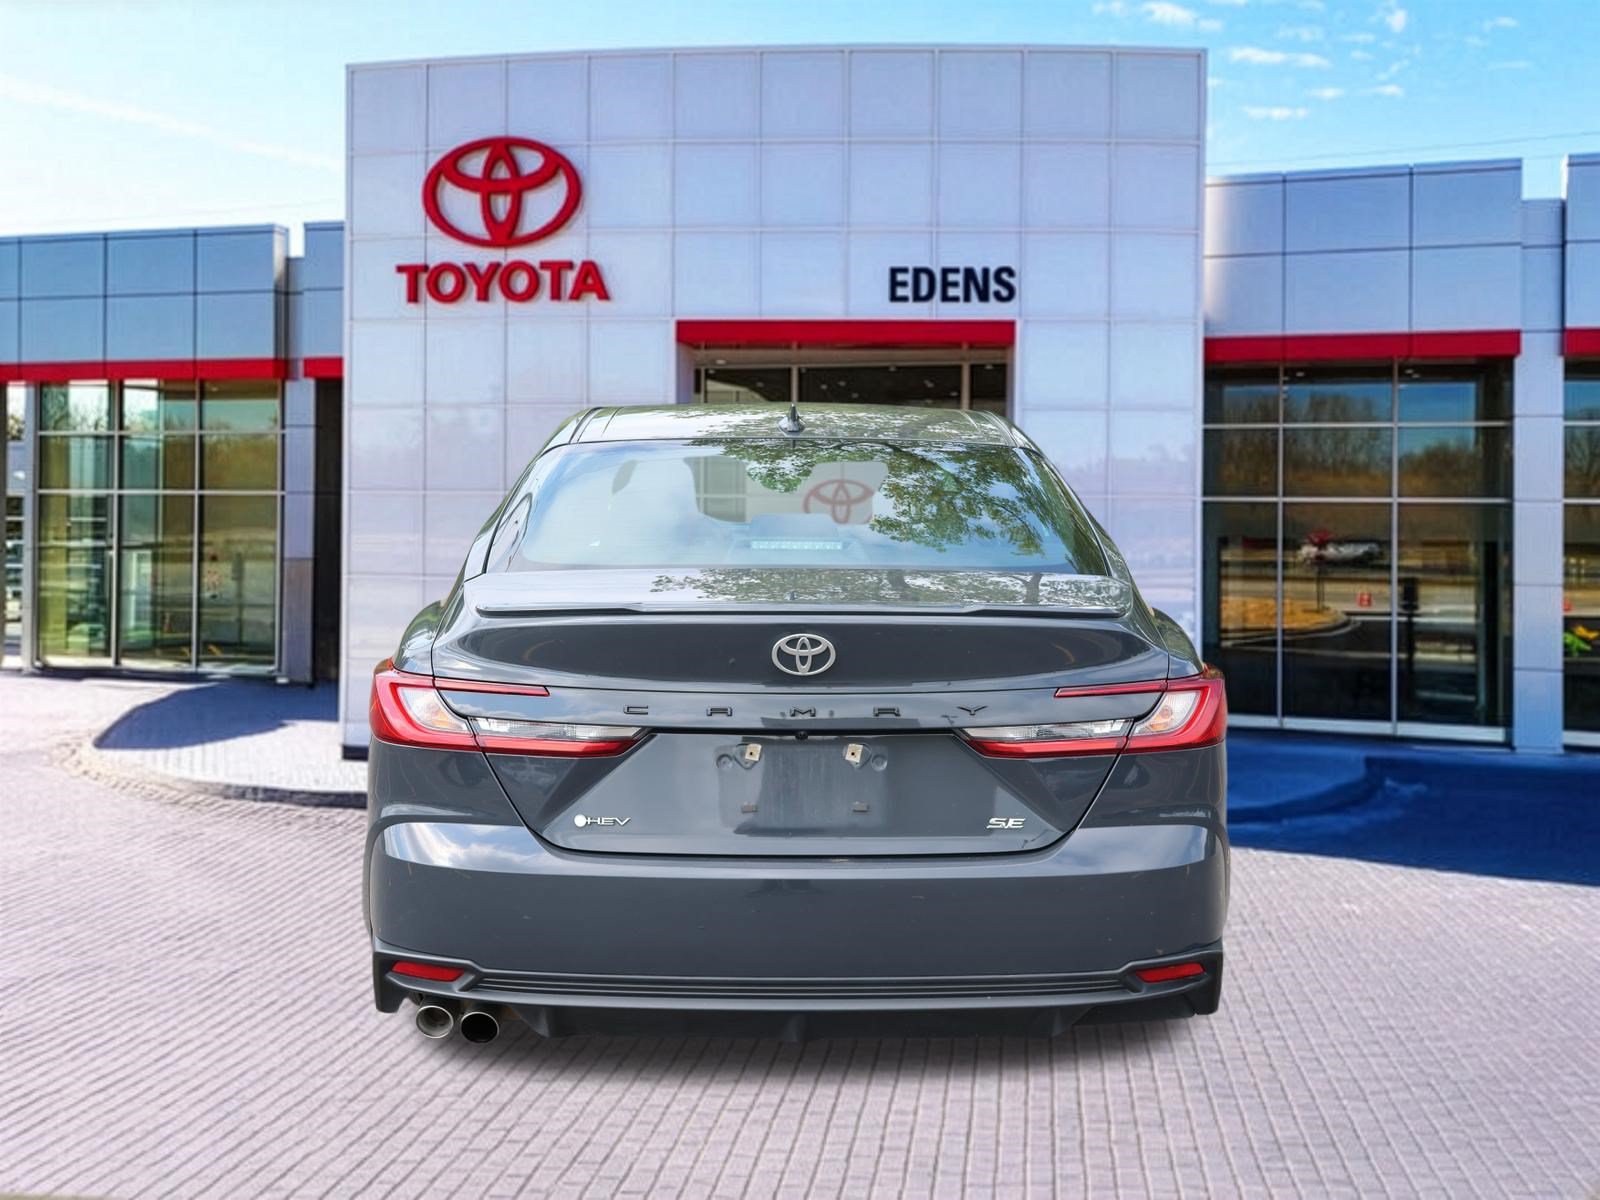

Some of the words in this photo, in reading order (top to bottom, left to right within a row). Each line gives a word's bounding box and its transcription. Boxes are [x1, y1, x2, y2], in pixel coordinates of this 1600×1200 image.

[396, 260, 611, 303] TOYOTA
[889, 266, 1017, 303] EDENS
[623, 704, 988, 717] CAMRY
[588, 816, 631, 826] HEV
[986, 817, 1025, 829] SE
